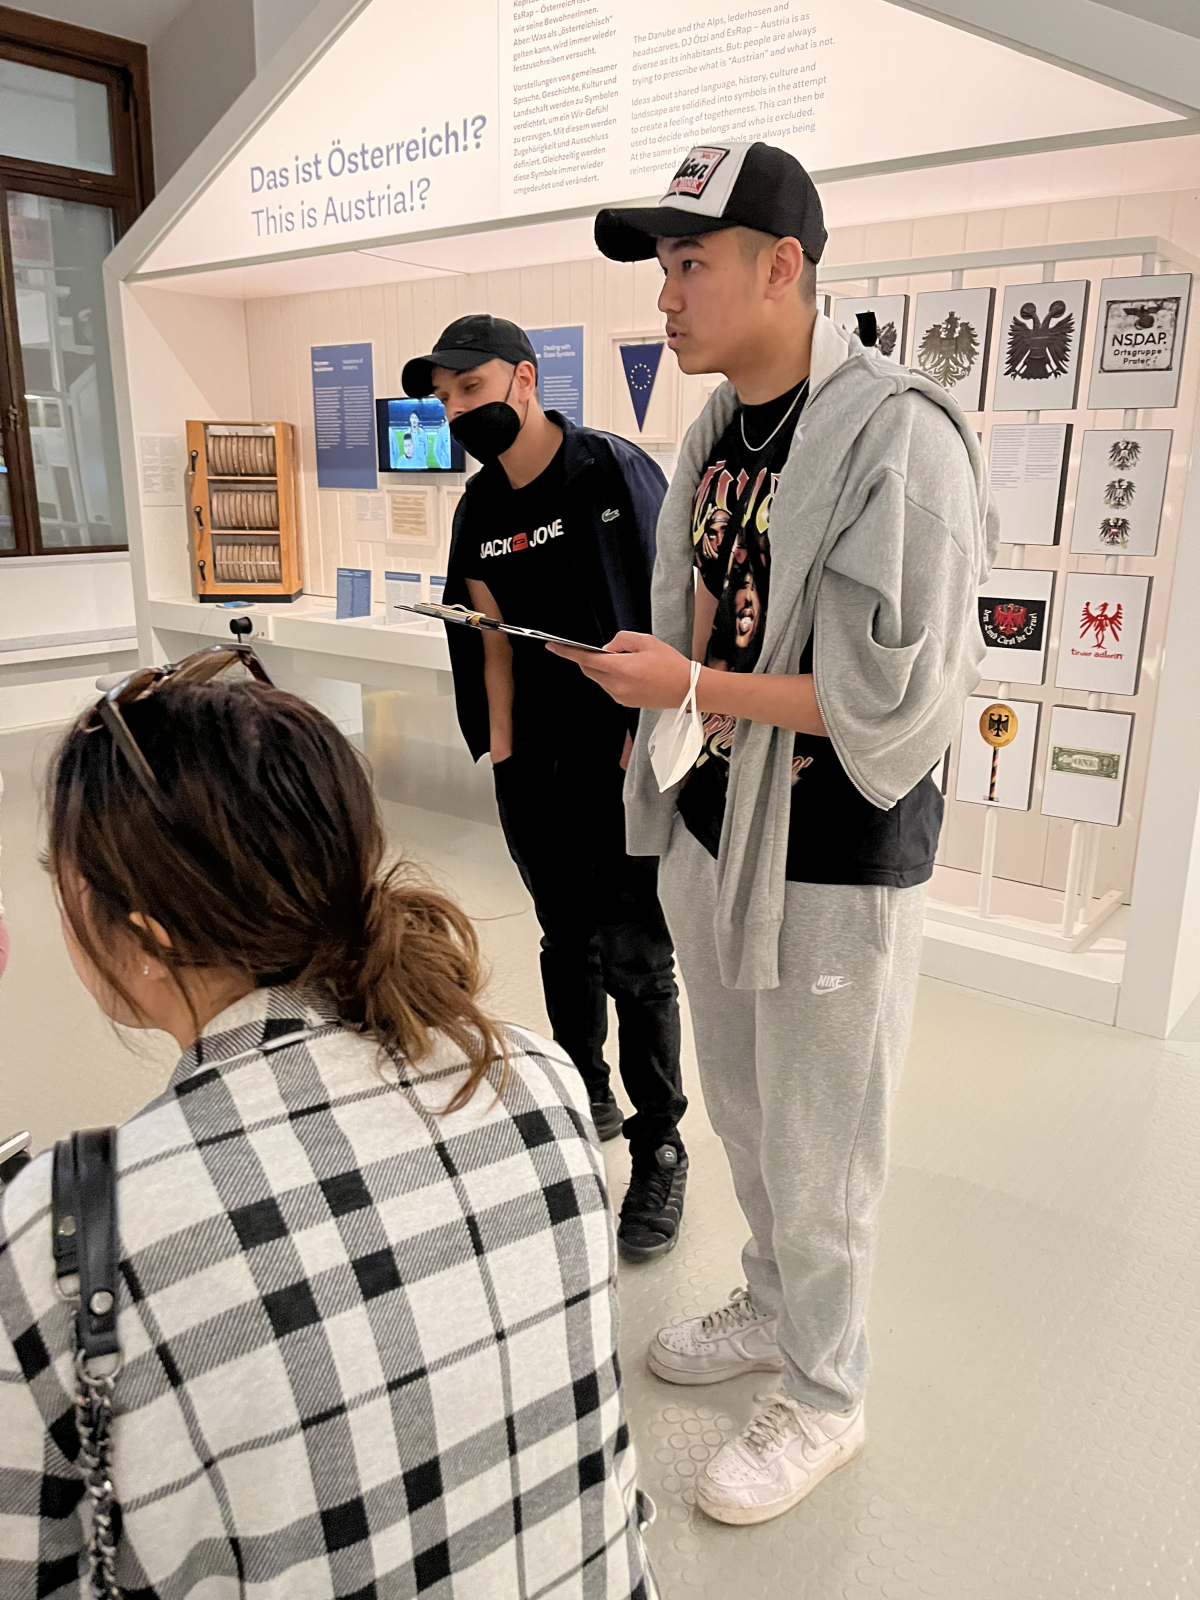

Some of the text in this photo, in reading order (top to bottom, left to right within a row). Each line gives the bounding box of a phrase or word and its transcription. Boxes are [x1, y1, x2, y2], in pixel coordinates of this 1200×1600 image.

[513, 10, 535, 21] EsRap
[540, 0, 576, 14] Österreich
[633, 1, 790, 44] The Danube and the Alps, lederhosen and
[513, 24, 526, 34] wie
[526, 20, 544, 31] seine
[531, 33, 547, 42] Was
[547, 29, 558, 39] als
[681, 37, 693, 48] DJ
[710, 29, 726, 41] and
[726, 25, 752, 37] EsRap
[760, 16, 790, 30] Austria
[791, 14, 799, 23] is
[800, 13, 810, 22] as
[513, 49, 534, 62] gelten
[553, 39, 569, 50] wird
[569, 35, 592, 46] immer
[592, 29, 617, 41] wieder
[632, 26, 817, 72] diverse as its inhabitants. But: people are always
[513, 47, 597, 73] festzuschreiben versucht.
[632, 75, 654, 87] trying
[654, 73, 663, 81] to
[663, 65, 698, 82] prescribe
[699, 60, 719, 72] what
[720, 58, 727, 67] is
[770, 45, 786, 57] and
[787, 41, 809, 53] what
[810, 39, 818, 49] is
[819, 37, 836, 47] not.
[513, 63, 618, 92] Vorstellungen von gemeinsamer
[541, 85, 581, 99] Geschichte,
[581, 80, 603, 90] Kultur
[603, 75, 617, 86] und
[631, 97, 651, 107] Ideas
[652, 91, 673, 103] about
[674, 85, 700, 98] shared
[739, 73, 769, 85] history,
[769, 67, 799, 79] culture
[800, 61, 817, 73] and
[513, 103, 549, 118] Landschaft
[549, 99, 575, 110] werden
[584, 90, 619, 105] Symbolen
[631, 75, 827, 120] landscape are solidified into symbols in the attempt
[513, 117, 548, 131] verdichtet,
[548, 116, 559, 124] um
[559, 112, 570, 122] ein
[639, 122, 663, 133] create
[669, 115, 694, 127] feeling
[695, 112, 704, 122] of
[704, 105, 757, 121] togetherness.
[758, 99, 776, 110] This
[776, 98, 792, 107] can
[793, 94, 813, 104] then
[814, 91, 825, 100] be
[553, 126, 565, 136] Mit
[565, 123, 590, 134] diesem
[590, 117, 617, 129] werden
[630, 106, 815, 148] used to decide who belongs and who is excluded.
[749, 133, 762, 141] are
[763, 125, 791, 139] always
[792, 122, 816, 134] being
[250, 114, 488, 194] Das ist Österreich!?
[513, 133, 609, 158] Zugehörigkeit und Ausschluss
[513, 146, 606, 169] definiert. Gleichzeitig werden
[630, 153, 639, 162] At
[639, 151, 652, 160] the
[652, 148, 672, 158] same
[513, 160, 604, 182] diese Symbole immer wieder
[630, 159, 677, 175] reinterpreted
[513, 174, 599, 196] umgedeutet und verändert.
[251, 177, 431, 237] This is Austria!?
[1113, 349, 1162, 358] Ortsgruppe
[480, 536, 513, 559] JACK
[816, 975, 845, 988] NIKE
